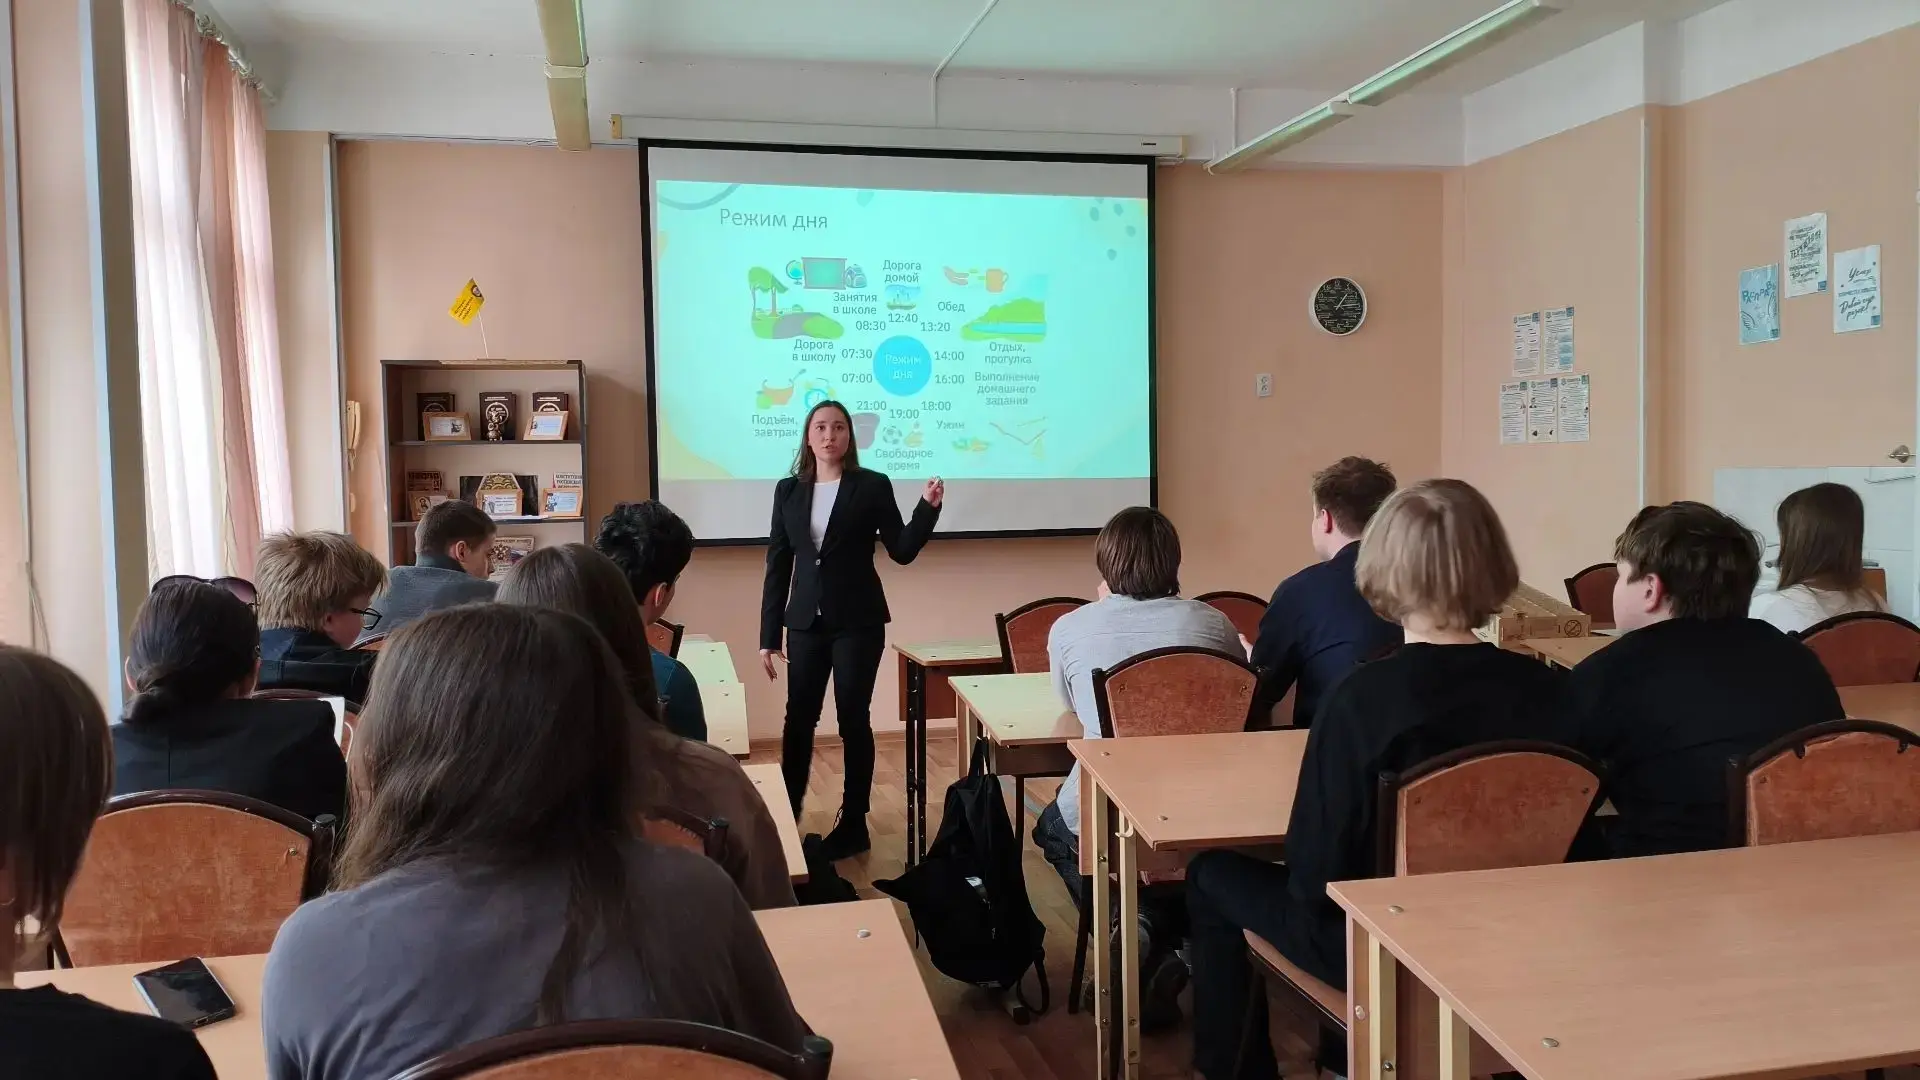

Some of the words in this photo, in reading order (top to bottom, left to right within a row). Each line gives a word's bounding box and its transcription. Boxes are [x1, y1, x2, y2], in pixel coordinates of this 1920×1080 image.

[719, 208, 787, 228] Режим
[792, 214, 828, 231] дня
[882, 260, 922, 272] Дорога
[884, 272, 920, 283] домой
[833, 292, 878, 303] Занятия
[833, 306, 839, 314] в
[842, 305, 877, 315] школе
[937, 302, 966, 313] Обед
[888, 313, 918, 323] 12:40
[855, 320, 886, 331] 08:30
[920, 322, 951, 332] 13:20
[793, 339, 834, 350] Дорога
[989, 341, 1026, 353] Отдых,
[792, 353, 798, 361] в
[801, 353, 836, 364] школу
[841, 349, 872, 359] 07:30
[934, 351, 965, 361] 14:00
[885, 354, 921, 365] Режим
[984, 355, 1032, 366] прогулка
[841, 373, 873, 383] 07:00
[892, 370, 913, 380] дня
[935, 374, 965, 384] 16:00
[974, 371, 1040, 382] Выполнение
[977, 385, 1036, 395] домашнего
[856, 401, 887, 411] 21:00
[921, 401, 951, 411] 18:00
[985, 397, 1028, 406] задания
[890, 409, 919, 419] 19:00
[751, 414, 798, 426] Подъём,
[936, 420, 965, 430] Ужин
[754, 428, 799, 438] завтрак
[875, 448, 934, 459] Свободное
